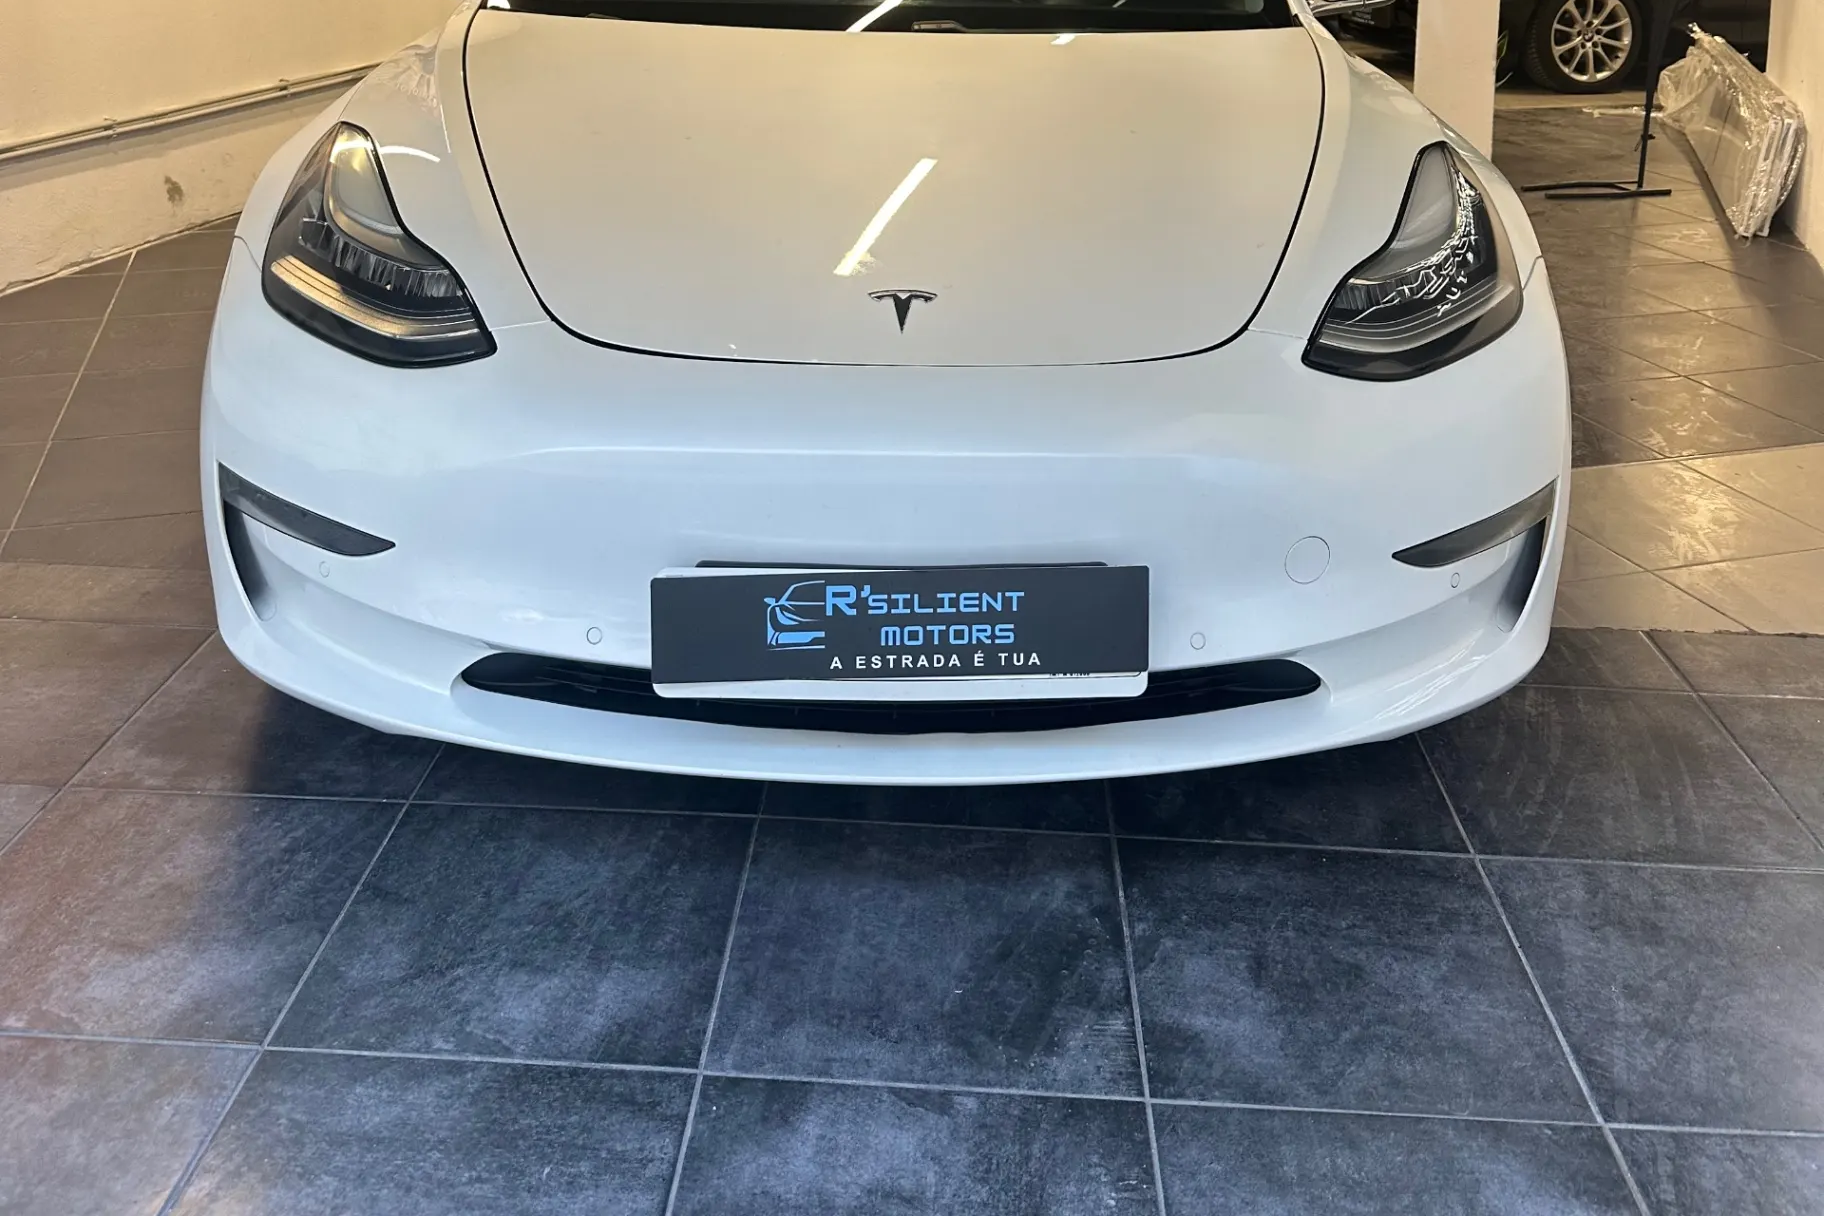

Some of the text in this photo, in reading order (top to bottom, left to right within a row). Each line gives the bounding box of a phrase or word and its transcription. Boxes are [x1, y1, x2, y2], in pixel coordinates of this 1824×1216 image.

[825, 585, 1025, 616] R'SILIENT
[880, 624, 1015, 646] MOTORS
[830, 650, 1041, 670] A ESTRADA É TUA
